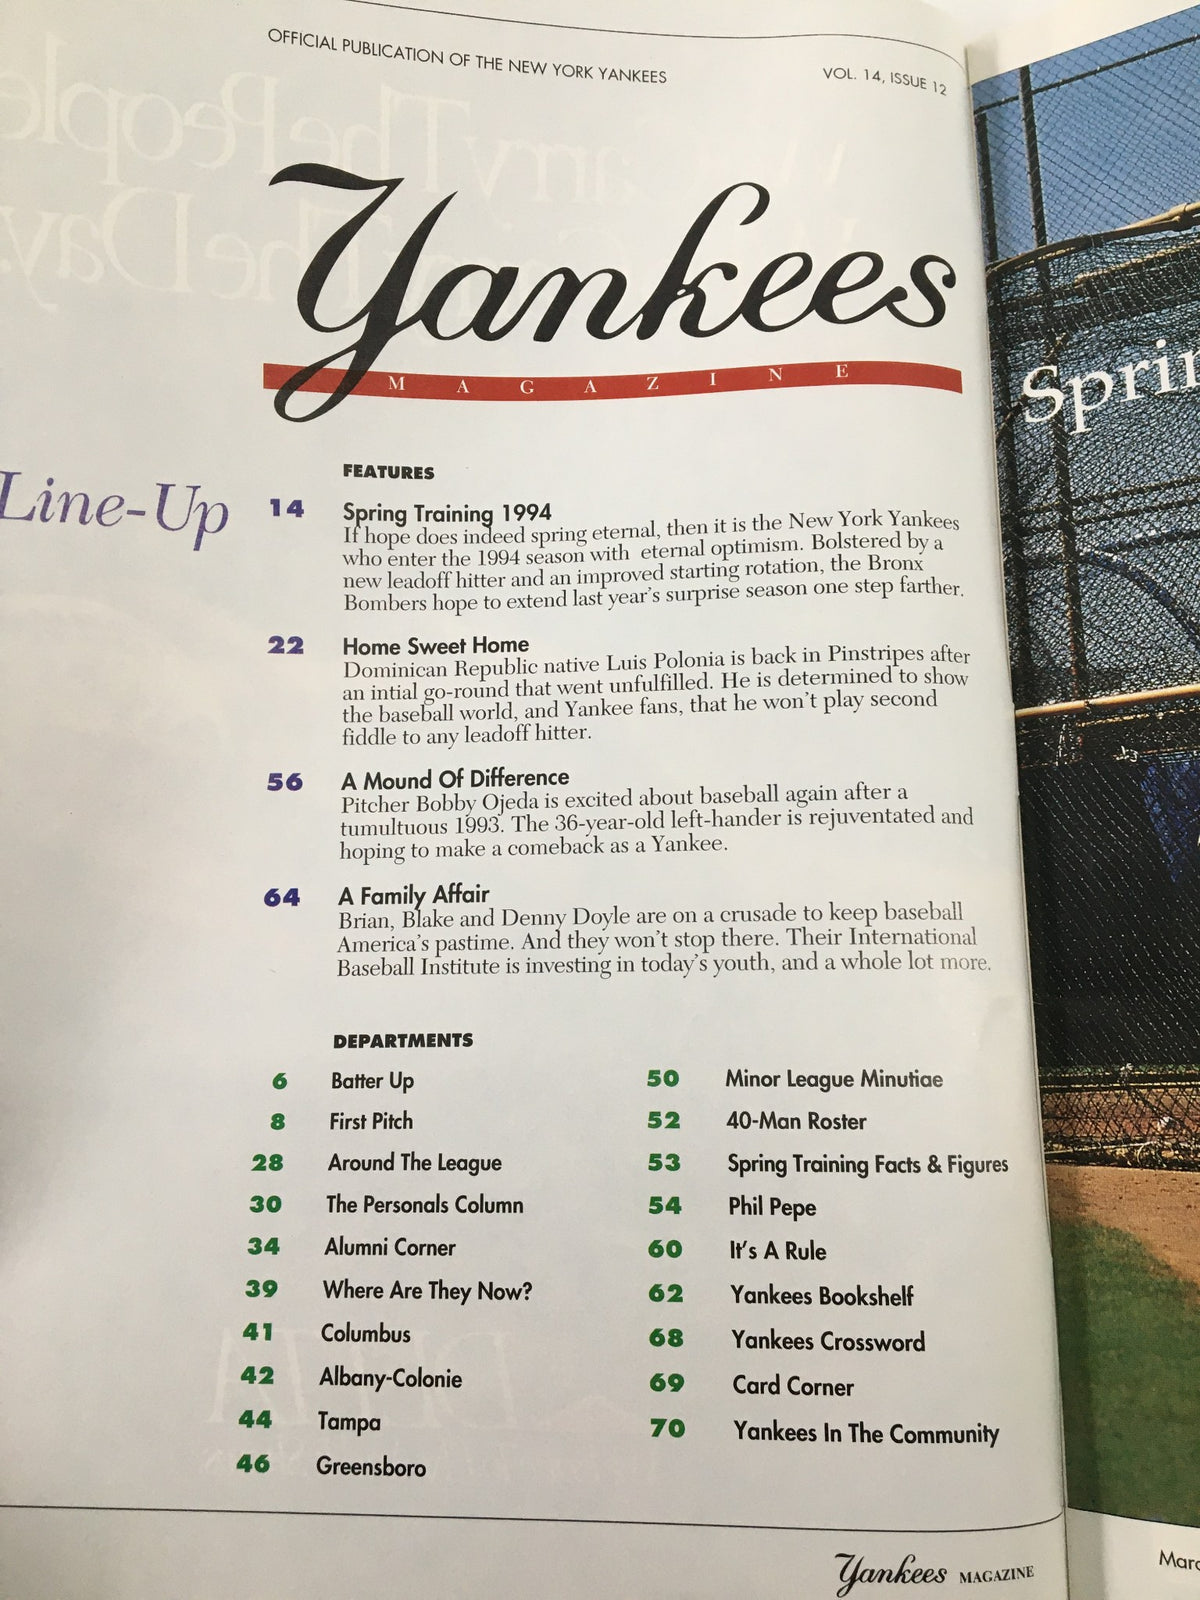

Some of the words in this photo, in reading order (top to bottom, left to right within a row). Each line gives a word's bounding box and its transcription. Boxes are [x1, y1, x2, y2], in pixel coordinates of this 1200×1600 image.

[268, 29, 337, 51] OFFICIAL
[343, 39, 443, 64] PUBLICATION
[449, 53, 470, 66] OF
[476, 55, 502, 71] THE
[509, 59, 547, 75] NEW
[553, 64, 593, 79] YORK
[599, 67, 667, 83] YANKEES
[823, 68, 856, 79] VOL.
[865, 69, 885, 83] 14,
[891, 72, 926, 89] ISSUE
[934, 81, 946, 96] 12
[267, 161, 956, 423] Yankees
[343, 464, 434, 480] FEATURES
[0, 470, 229, 551] Line-Up
[270, 499, 304, 518] 14
[344, 502, 407, 528] Spring
[414, 504, 493, 527] Training
[503, 503, 552, 521] 1994
[344, 527, 358, 543] If
[365, 526, 410, 550] hope
[416, 527, 457, 544] does
[464, 527, 525, 544] indeed
[531, 527, 587, 549] spring
[592, 520, 660, 540] eternal,
[667, 519, 708, 536] then
[714, 519, 726, 533] it
[732, 518, 746, 532] is
[752, 514, 782, 531] the
[789, 513, 833, 529] New
[838, 509, 883, 527] York
[888, 510, 959, 530] Yankees
[344, 593, 426, 611] Bombers
[433, 593, 478, 616] hope
[484, 596, 501, 609] to
[507, 589, 567, 609] extend
[573, 589, 603, 606] last
[608, 587, 660, 610] year's
[666, 584, 739, 607] surprise
[746, 584, 807, 598] season
[814, 583, 848, 594] one
[855, 579, 893, 599] step
[900, 575, 963, 596] farther.
[267, 636, 304, 654] 22
[344, 637, 401, 655] Home
[408, 637, 467, 655] Sweet
[473, 636, 529, 653] Home
[343, 727, 396, 745] fiddle
[403, 731, 420, 744] to
[427, 733, 459, 750] any
[465, 723, 531, 743] leadoff
[535, 723, 591, 740] hitter.
[267, 773, 303, 791] 56
[341, 772, 357, 790] A
[364, 769, 432, 790] Mound
[439, 767, 464, 788] Of
[471, 766, 569, 787] Difference
[341, 818, 447, 836] tumultuous
[456, 816, 504, 834] 1993.
[511, 814, 549, 832] The
[555, 810, 664, 837] 36-year-old
[671, 807, 781, 828] left-hander
[787, 809, 802, 825] is
[809, 805, 935, 831] rejuventated
[942, 807, 973, 825] and
[264, 888, 300, 907] 64
[338, 887, 354, 905] A
[361, 884, 426, 910] Family
[432, 882, 490, 903] Affair
[337, 934, 429, 952] America's
[435, 934, 514, 958] pastime.
[521, 930, 561, 950] And
[568, 930, 609, 955] they
[615, 929, 668, 947] won't
[675, 932, 715, 954] stop
[722, 927, 779, 946] there.
[786, 926, 842, 945] Their
[849, 926, 976, 945] International
[334, 1033, 473, 1049] DEPARTMENTS
[272, 1073, 287, 1089] 6
[332, 1072, 384, 1089] Batter
[390, 1071, 414, 1094] Up
[647, 1069, 679, 1087] 50
[726, 1069, 781, 1087] Minor
[787, 1069, 854, 1093] League
[861, 1069, 943, 1087] Minutiae
[271, 1113, 285, 1130] 8
[330, 1112, 367, 1130] First
[372, 1110, 413, 1129] Pitch
[648, 1111, 680, 1129] 52
[726, 1111, 801, 1129] 40-Man
[808, 1112, 867, 1130] Roster
[251, 1154, 283, 1171] 28
[328, 1151, 395, 1171] Around
[401, 1151, 432, 1171] The
[438, 1153, 502, 1176] League
[648, 1153, 680, 1171] 53
[728, 1153, 787, 1178] Spring
[793, 1154, 868, 1179] Training
[875, 1155, 921, 1173] Facts
[927, 1155, 942, 1173] &
[948, 1154, 1008, 1179] Figures
[250, 1195, 282, 1213] 30
[326, 1193, 357, 1213] The
[364, 1193, 449, 1213] Personals
[455, 1193, 523, 1213] Column
[649, 1196, 682, 1214] 54
[729, 1195, 763, 1215] Phil
[770, 1197, 816, 1222] Pepe
[248, 1237, 280, 1255] 34
[324, 1235, 388, 1256] Alumni
[394, 1237, 456, 1256] Corner
[648, 1240, 682, 1258] 60
[730, 1240, 757, 1259] It's
[764, 1241, 779, 1259] A
[786, 1239, 826, 1260] Rule
[245, 1280, 278, 1297] 39
[323, 1278, 384, 1299] Where
[389, 1280, 422, 1299] Are
[428, 1279, 472, 1305] They
[478, 1281, 532, 1301] Now?
[649, 1284, 683, 1302] 62
[730, 1283, 812, 1305] Yankees
[819, 1284, 914, 1306] Bookshelf
[243, 1323, 272, 1341] 41
[321, 1321, 411, 1343] Columbus
[649, 1328, 683, 1347] 68
[732, 1328, 814, 1350] Yankees
[821, 1330, 925, 1352] Crossword
[241, 1366, 274, 1384] 42
[319, 1365, 462, 1392] Albany-Colonie
[650, 1373, 684, 1392] 69
[733, 1373, 780, 1395] Card
[787, 1376, 854, 1396] Corner
[239, 1410, 272, 1428] 44
[318, 1411, 381, 1437] Tampa
[651, 1418, 685, 1438] 70
[734, 1419, 817, 1442] Yankees
[824, 1422, 842, 1442] In
[848, 1421, 883, 1443] The
[890, 1423, 1000, 1448] Community
[236, 1454, 270, 1473] 46
[316, 1455, 426, 1477] Greensboro
[835, 1553, 947, 1598] Yankees
[960, 1566, 1034, 1583] MAGAZINE
